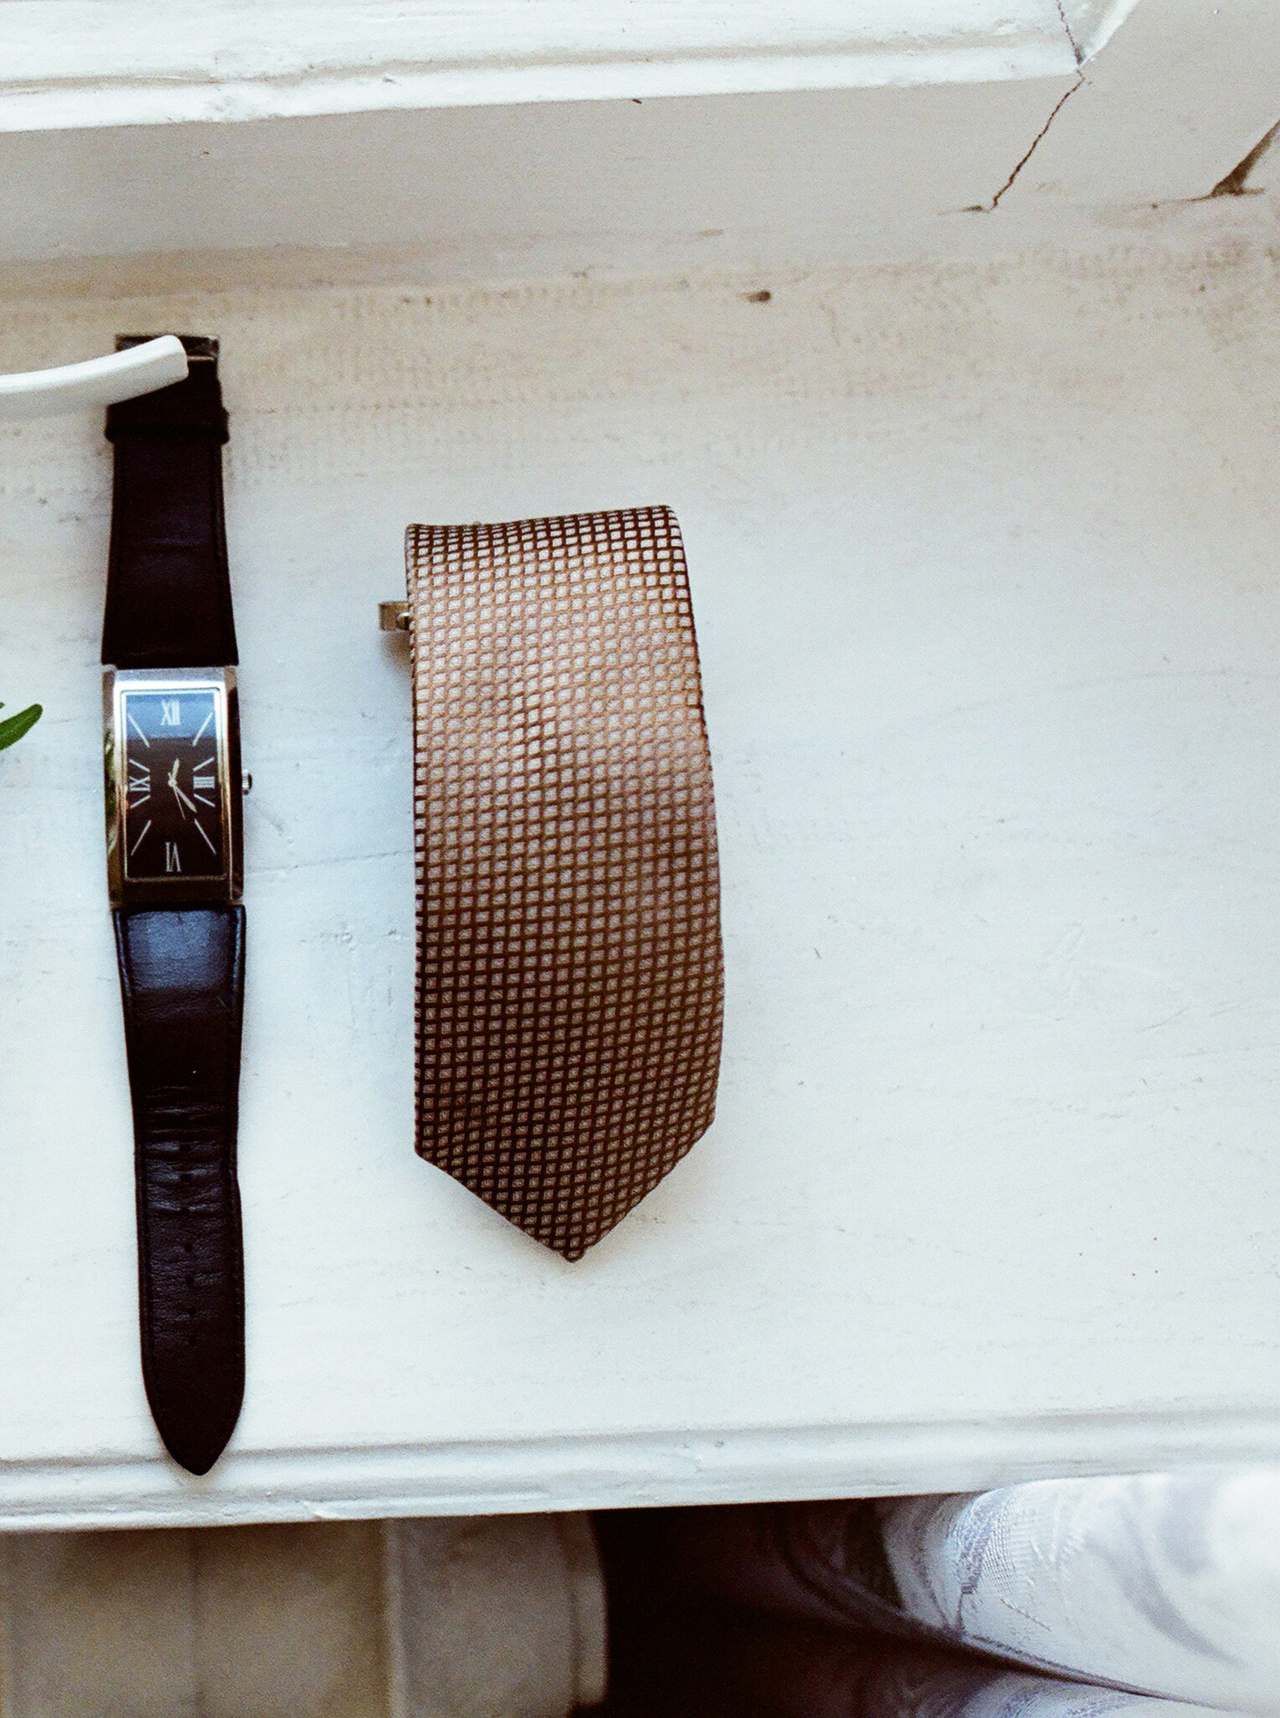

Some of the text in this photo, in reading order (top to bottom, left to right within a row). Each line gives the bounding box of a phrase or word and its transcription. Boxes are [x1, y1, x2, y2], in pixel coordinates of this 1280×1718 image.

[160, 699, 182, 726] XII
[129, 776, 151, 792] IX
[193, 776, 215, 789] III
[165, 841, 182, 873] VI
